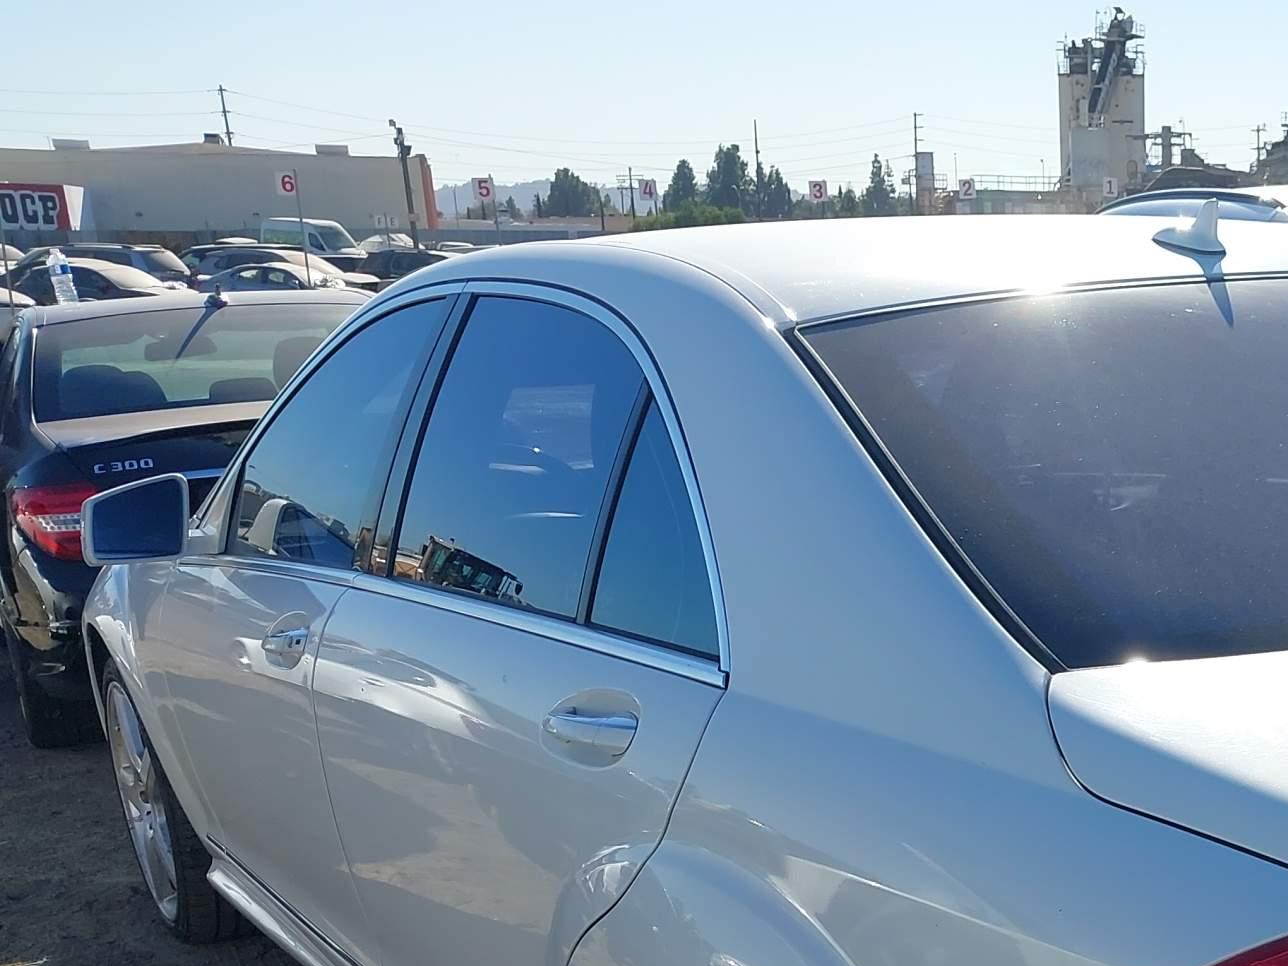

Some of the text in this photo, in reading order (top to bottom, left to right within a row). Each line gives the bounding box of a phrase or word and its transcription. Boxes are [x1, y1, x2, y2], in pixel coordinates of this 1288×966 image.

[281, 174, 295, 192] 6
[478, 180, 490, 197] 5
[643, 181, 653, 198] 4
[813, 183, 824, 199] 3
[962, 180, 973, 196] 2
[1106, 179, 1114, 194] 1
